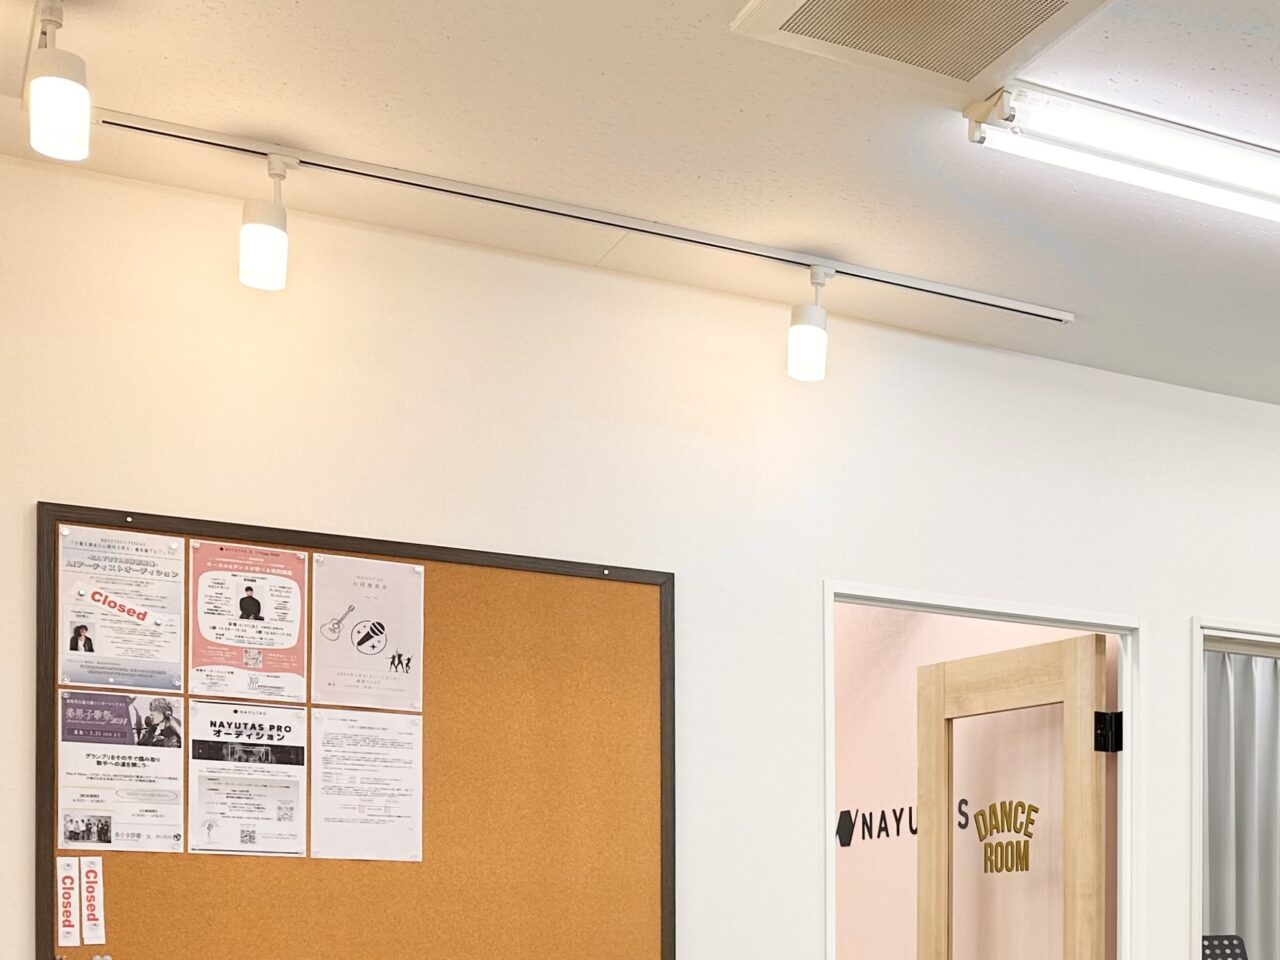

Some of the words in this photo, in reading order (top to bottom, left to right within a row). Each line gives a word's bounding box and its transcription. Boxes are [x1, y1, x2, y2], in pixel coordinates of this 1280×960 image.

[90, 591, 148, 621] Closed
[210, 720, 265, 732] NAYUTAS
[269, 724, 292, 733] PRO
[213, 728, 285, 741] オーディション
[861, 798, 969, 840] NAYUS
[974, 800, 1039, 842] DANCE
[984, 840, 1030, 873] ROOM
[61, 875, 75, 928] Closed
[85, 869, 99, 921] Closed
